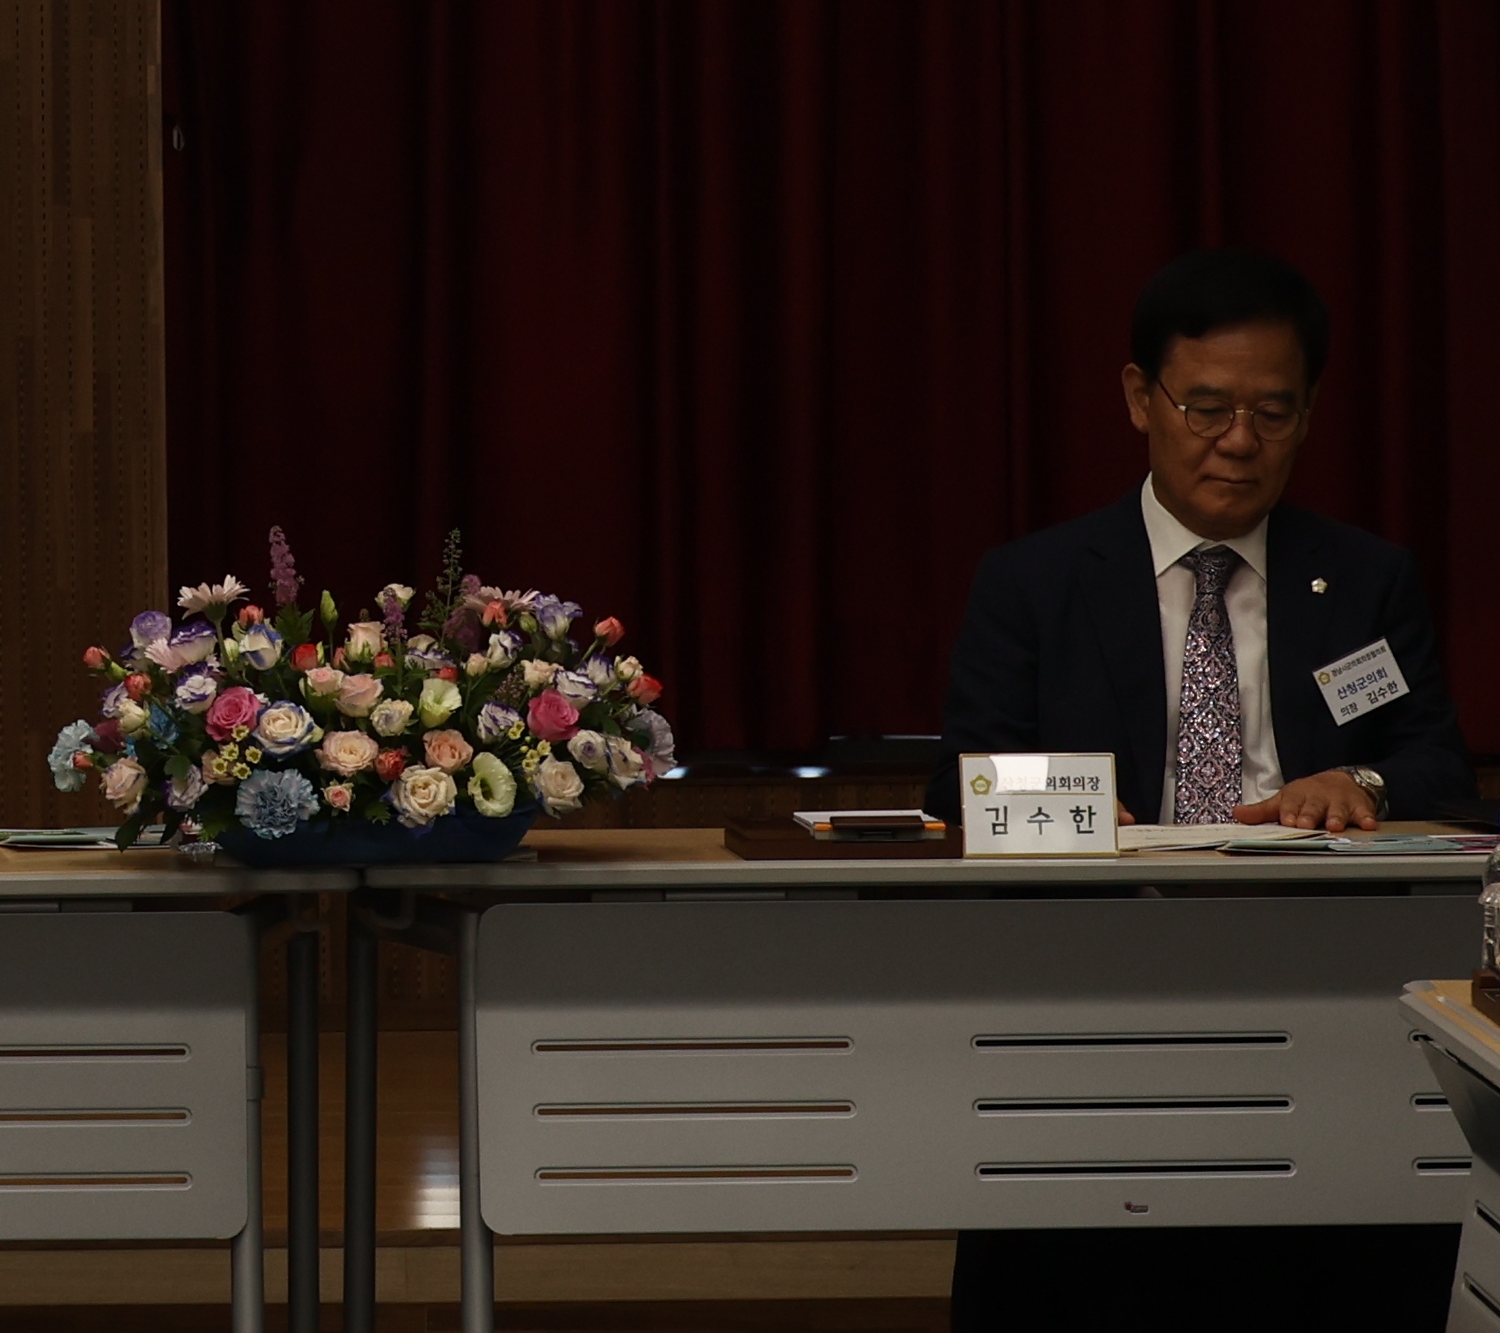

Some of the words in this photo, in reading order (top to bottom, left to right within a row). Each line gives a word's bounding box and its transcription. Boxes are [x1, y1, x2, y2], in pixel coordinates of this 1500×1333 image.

[1337, 666, 1388, 700] 산청군의회
[1366, 680, 1399, 705] 김수한
[984, 804, 1098, 836] 김수한
